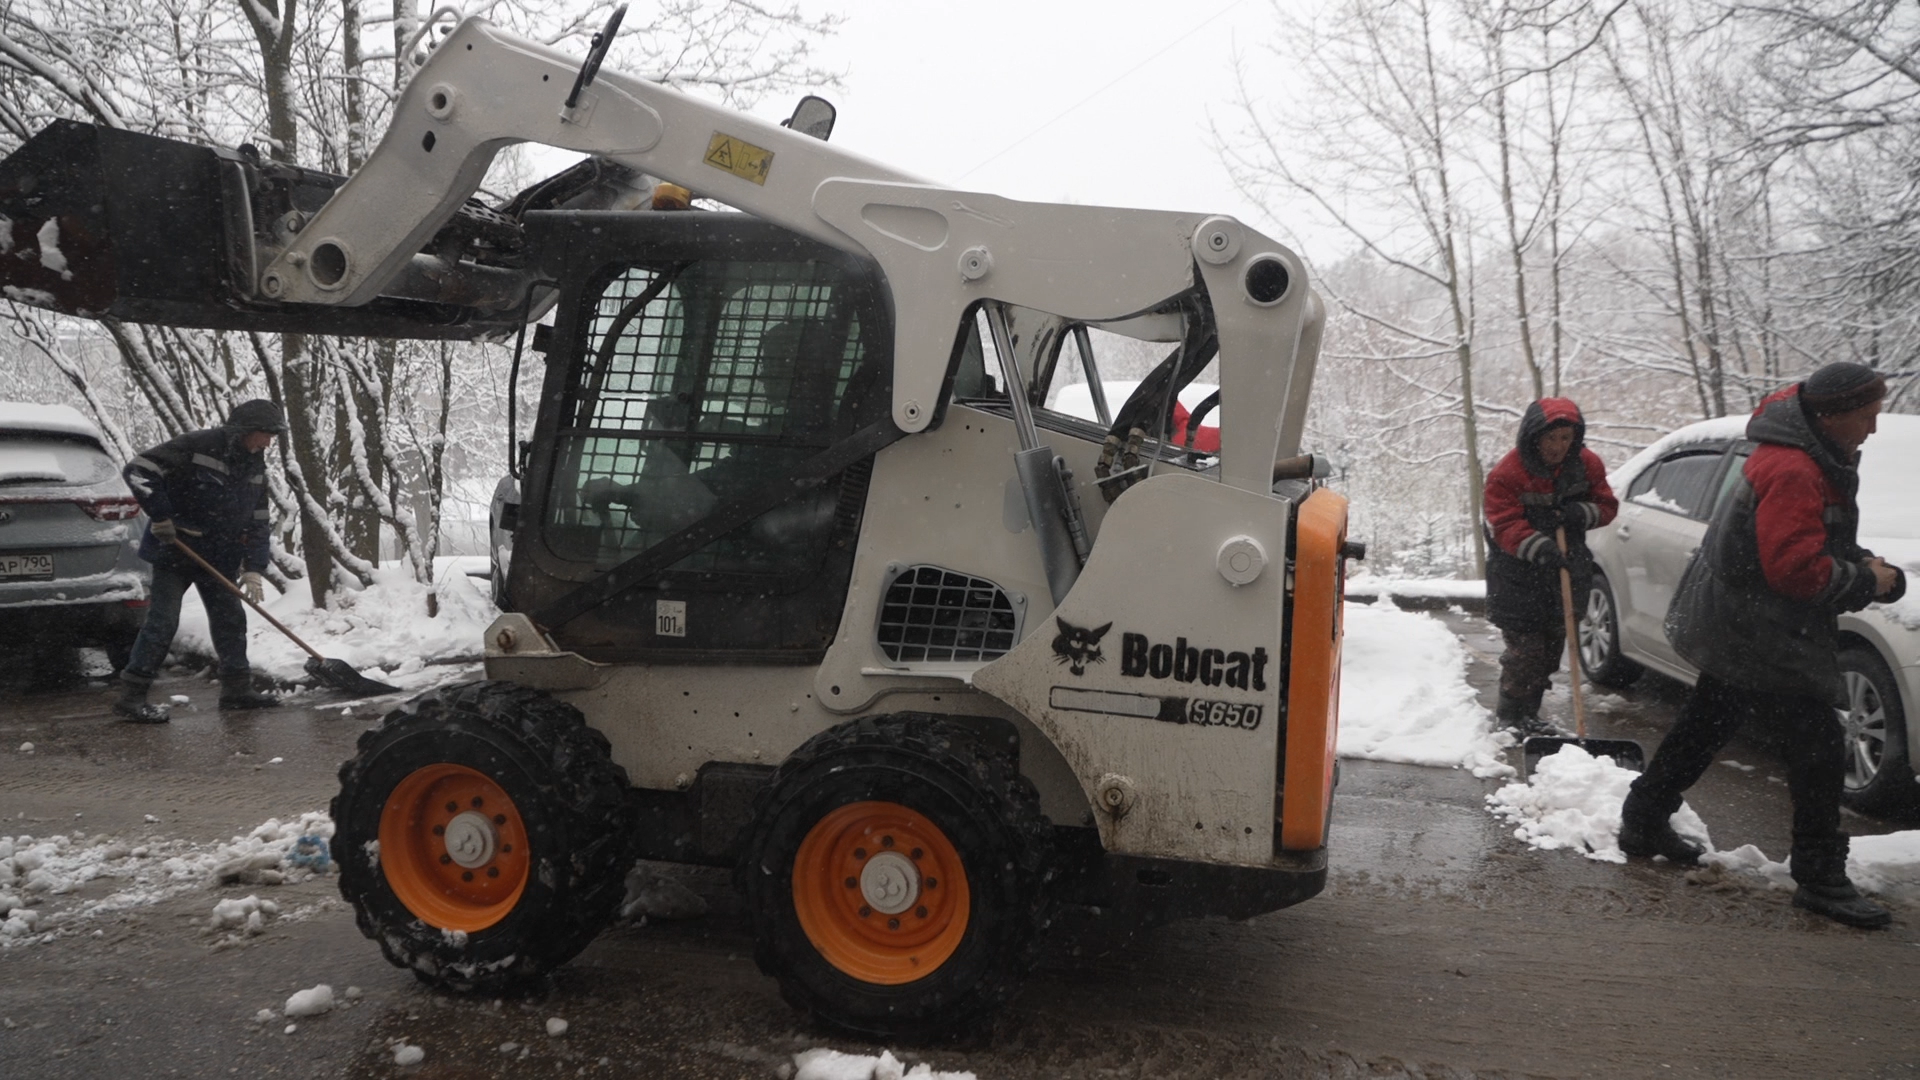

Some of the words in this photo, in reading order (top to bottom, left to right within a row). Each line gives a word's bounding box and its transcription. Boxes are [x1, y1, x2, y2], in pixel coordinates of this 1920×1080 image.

[22, 556, 48, 568] 790
[658, 615, 676, 634] 101
[1121, 632, 1268, 691] Bobcat
[1193, 699, 1260, 728] S650
